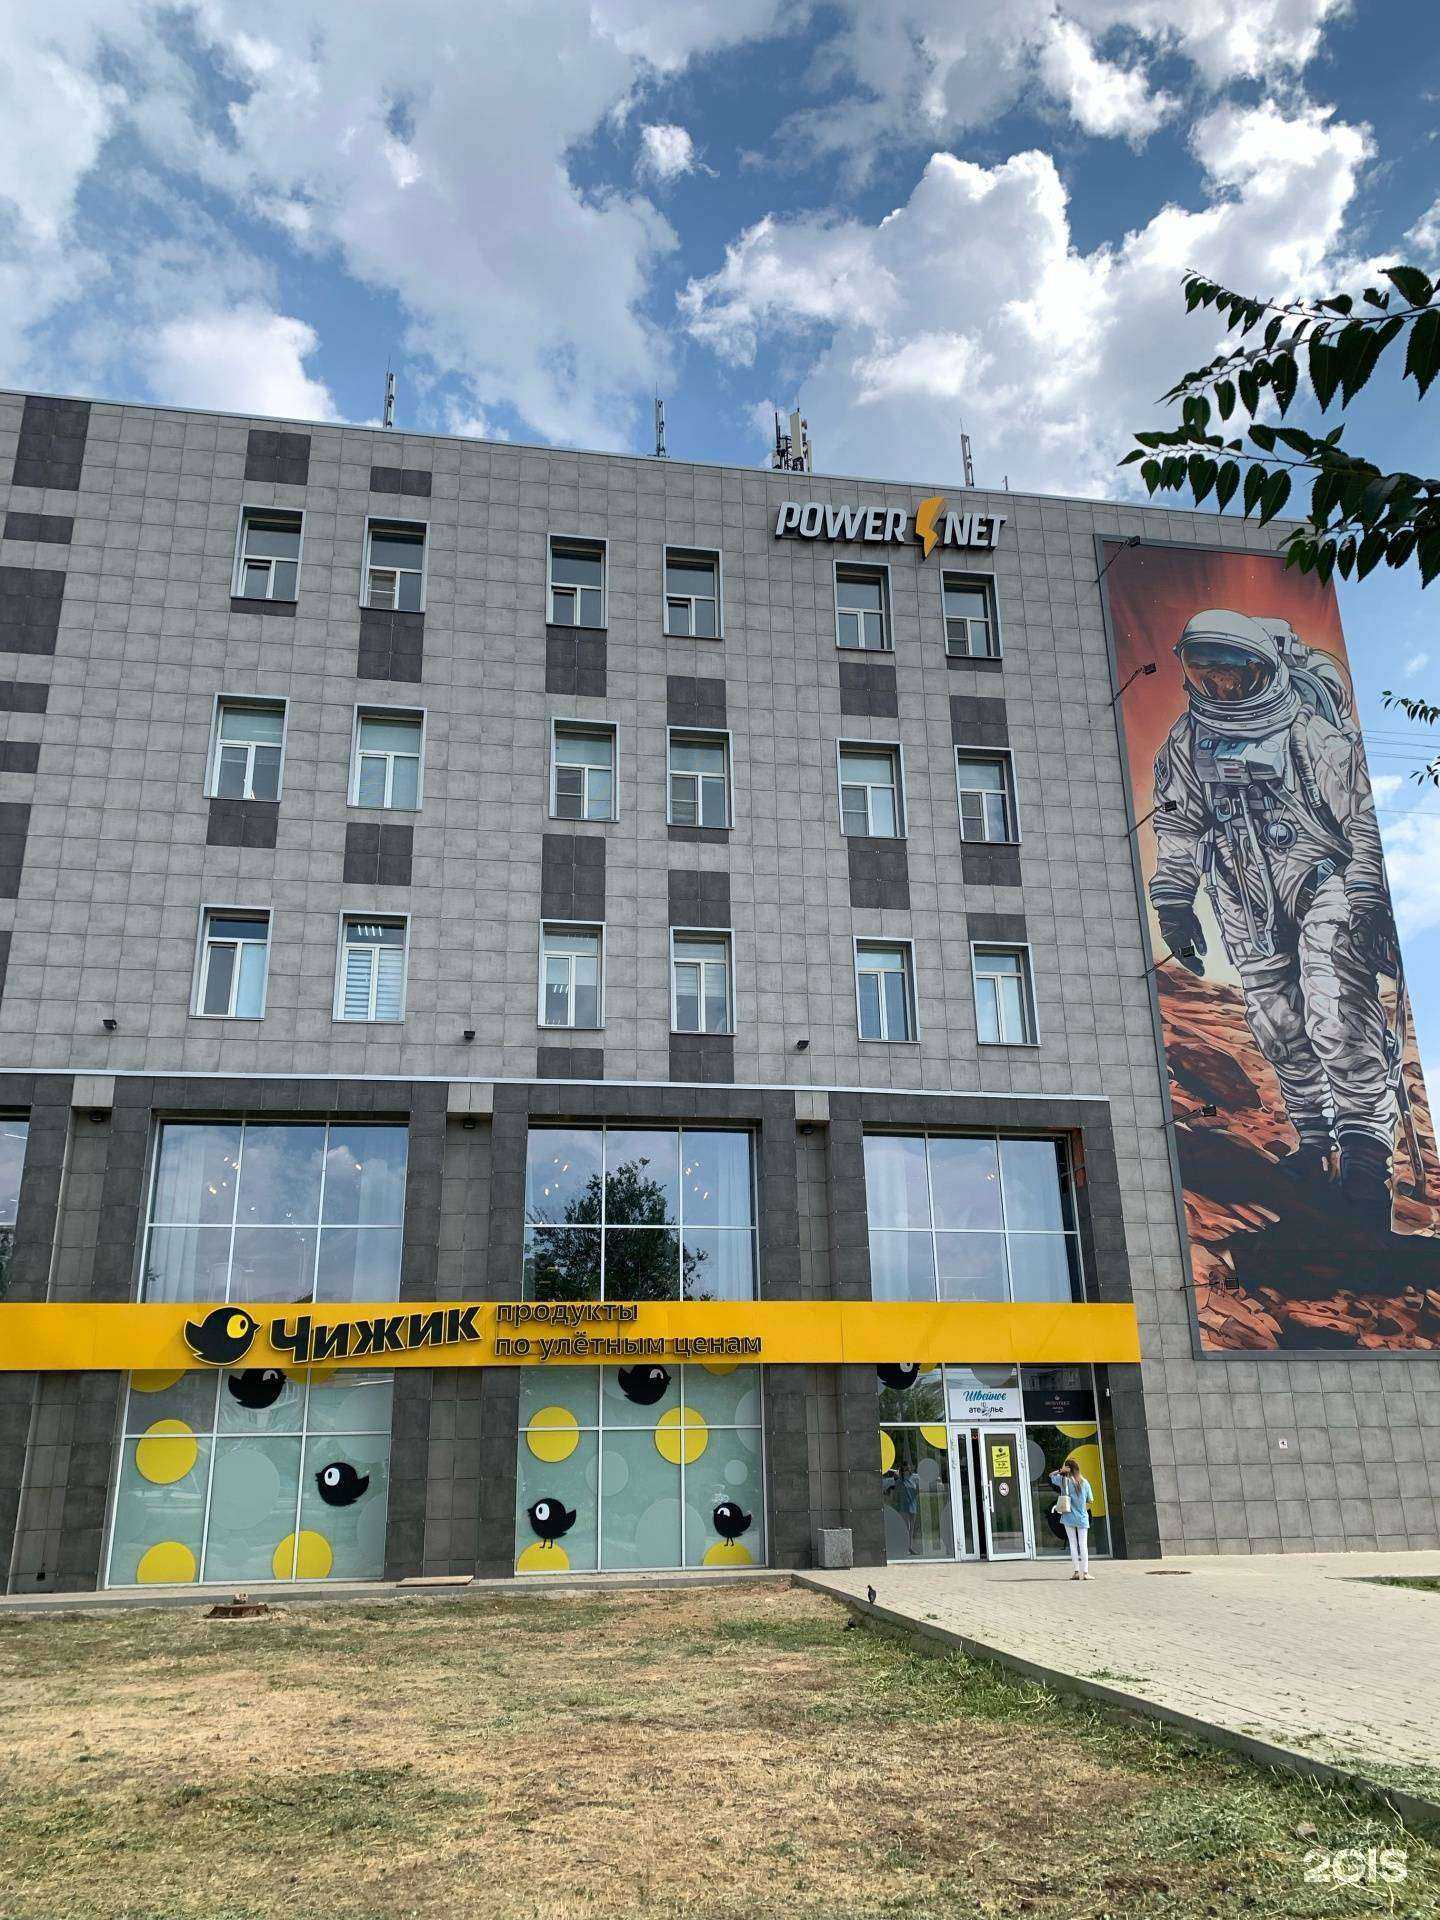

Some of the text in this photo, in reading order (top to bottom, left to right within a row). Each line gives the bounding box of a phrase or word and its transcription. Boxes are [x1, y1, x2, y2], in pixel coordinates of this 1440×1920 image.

[775, 501, 1008, 550] POWER NET
[269, 1305, 482, 1364] Чижик
[495, 1303, 638, 1328] продукты
[494, 1331, 763, 1360] по улётным ценам
